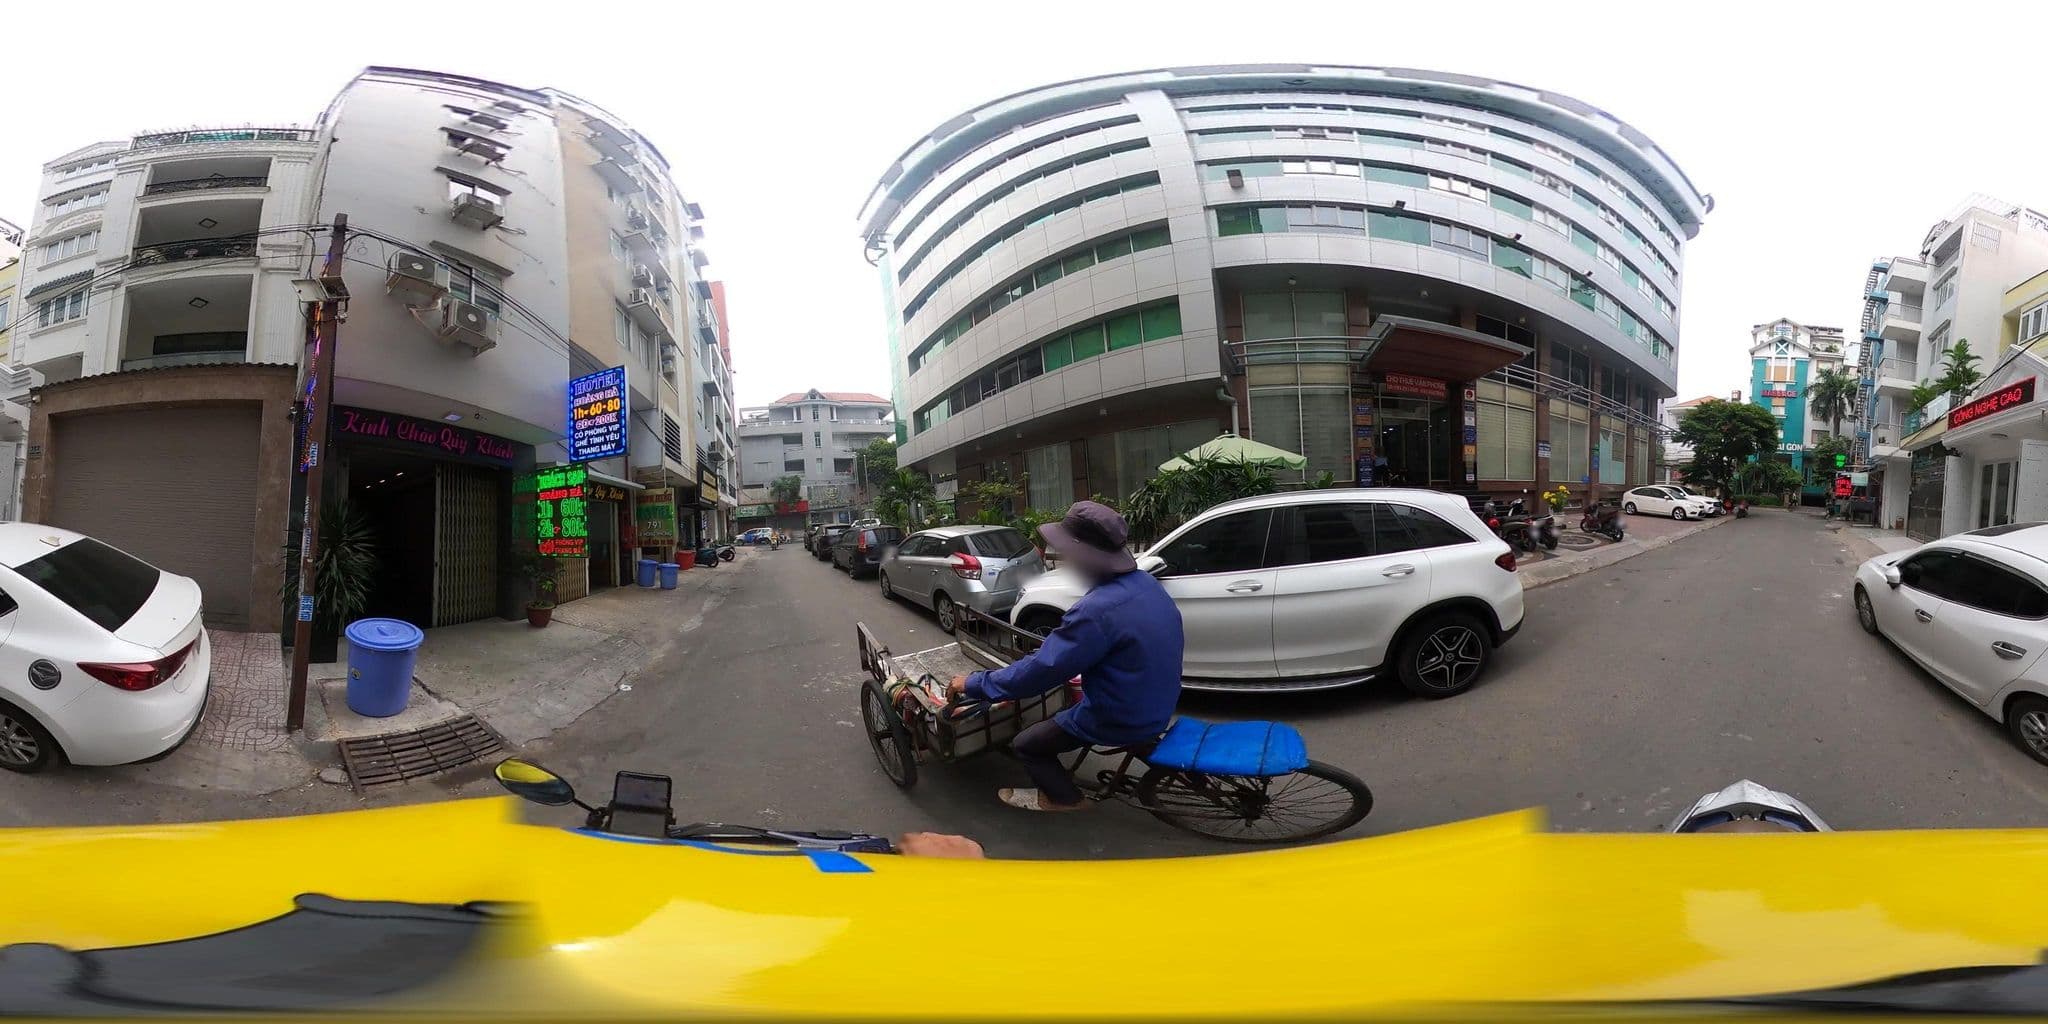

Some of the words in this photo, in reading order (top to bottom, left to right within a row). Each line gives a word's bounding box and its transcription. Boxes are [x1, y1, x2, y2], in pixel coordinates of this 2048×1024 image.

[574, 373, 620, 395] HOTEL
[2000, 388, 2022, 406] CAO
[584, 426, 607, 437] PHÒNG
[608, 424, 620, 432] VIP
[575, 437, 588, 447] GHẾ
[589, 435, 604, 445] TÌNH
[605, 432, 620, 441] YÊU
[578, 446, 600, 455] THANG
[601, 442, 616, 452] MÁY
